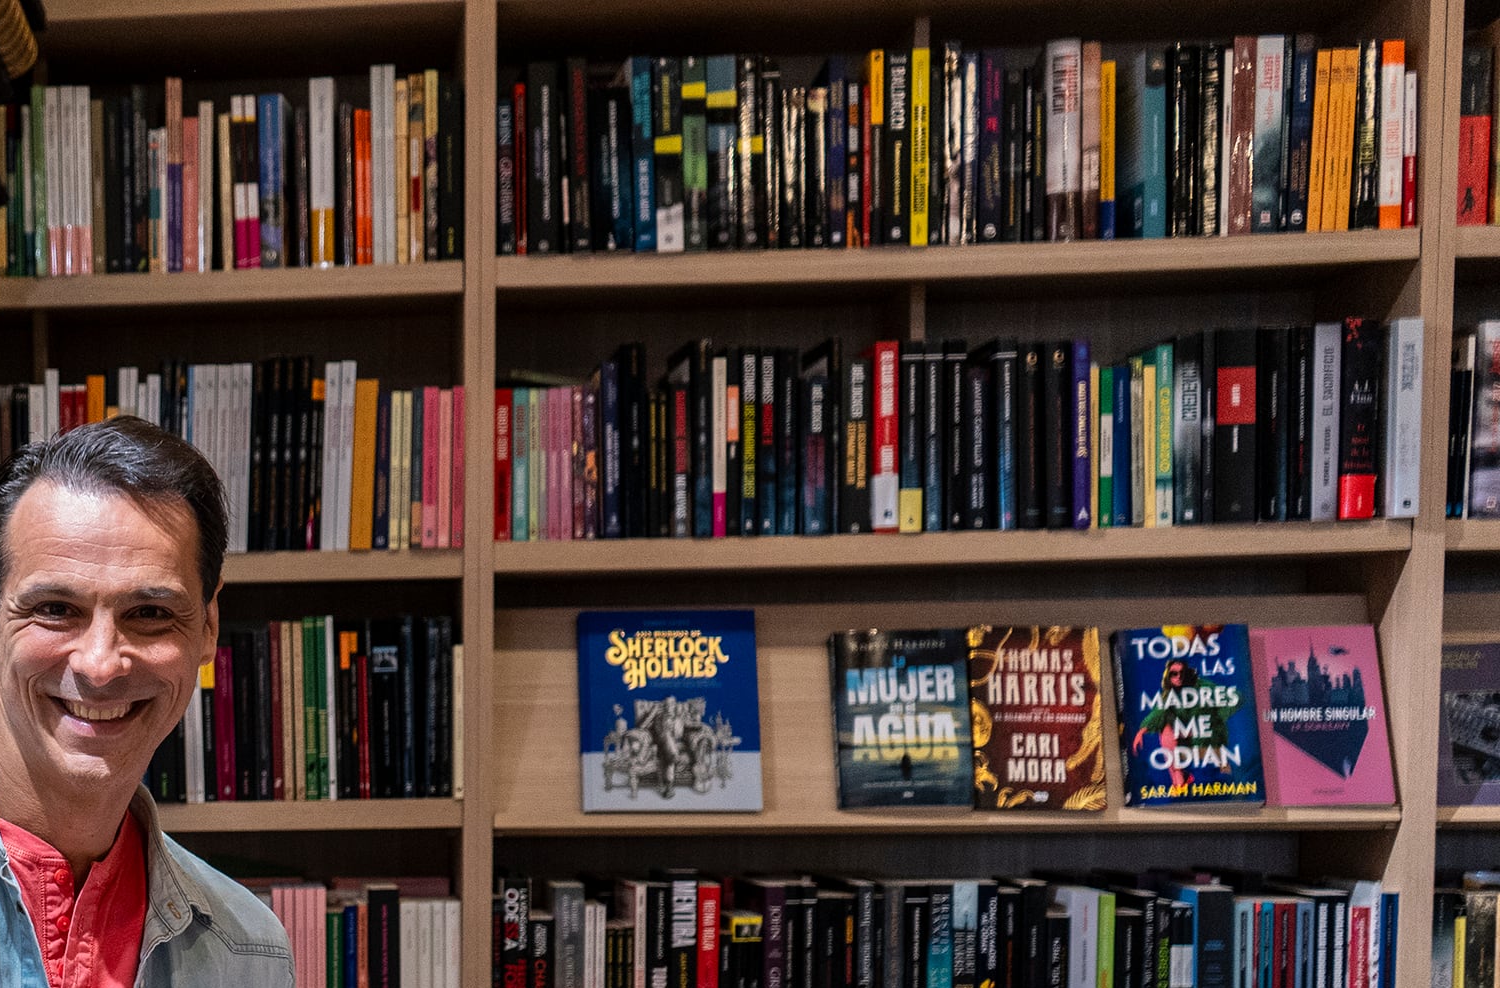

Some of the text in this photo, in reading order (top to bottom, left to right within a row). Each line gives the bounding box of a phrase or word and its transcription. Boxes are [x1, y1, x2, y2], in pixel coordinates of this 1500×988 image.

[605, 628, 730, 665] SHERLOCK
[1130, 633, 1221, 661] TODAS
[622, 655, 718, 691] HOLMES
[997, 648, 1074, 674] THOMAS
[1201, 657, 1236, 676] LAS
[846, 665, 956, 706] MUJER
[987, 673, 1087, 707] HARRIS
[1140, 685, 1240, 711] MADRES
[1173, 715, 1213, 739] ME
[1263, 706, 1378, 722] UN HOMBRE SINGULAR
[852, 712, 959, 762] AGUA
[1011, 732, 1061, 758] CARI
[1007, 758, 1067, 783] MORA
[1148, 745, 1242, 770] ODIAN
[1140, 784, 1191, 800] SARAH
[1192, 781, 1257, 798] HARMAN
[671, 880, 697, 949] MENTIRA
